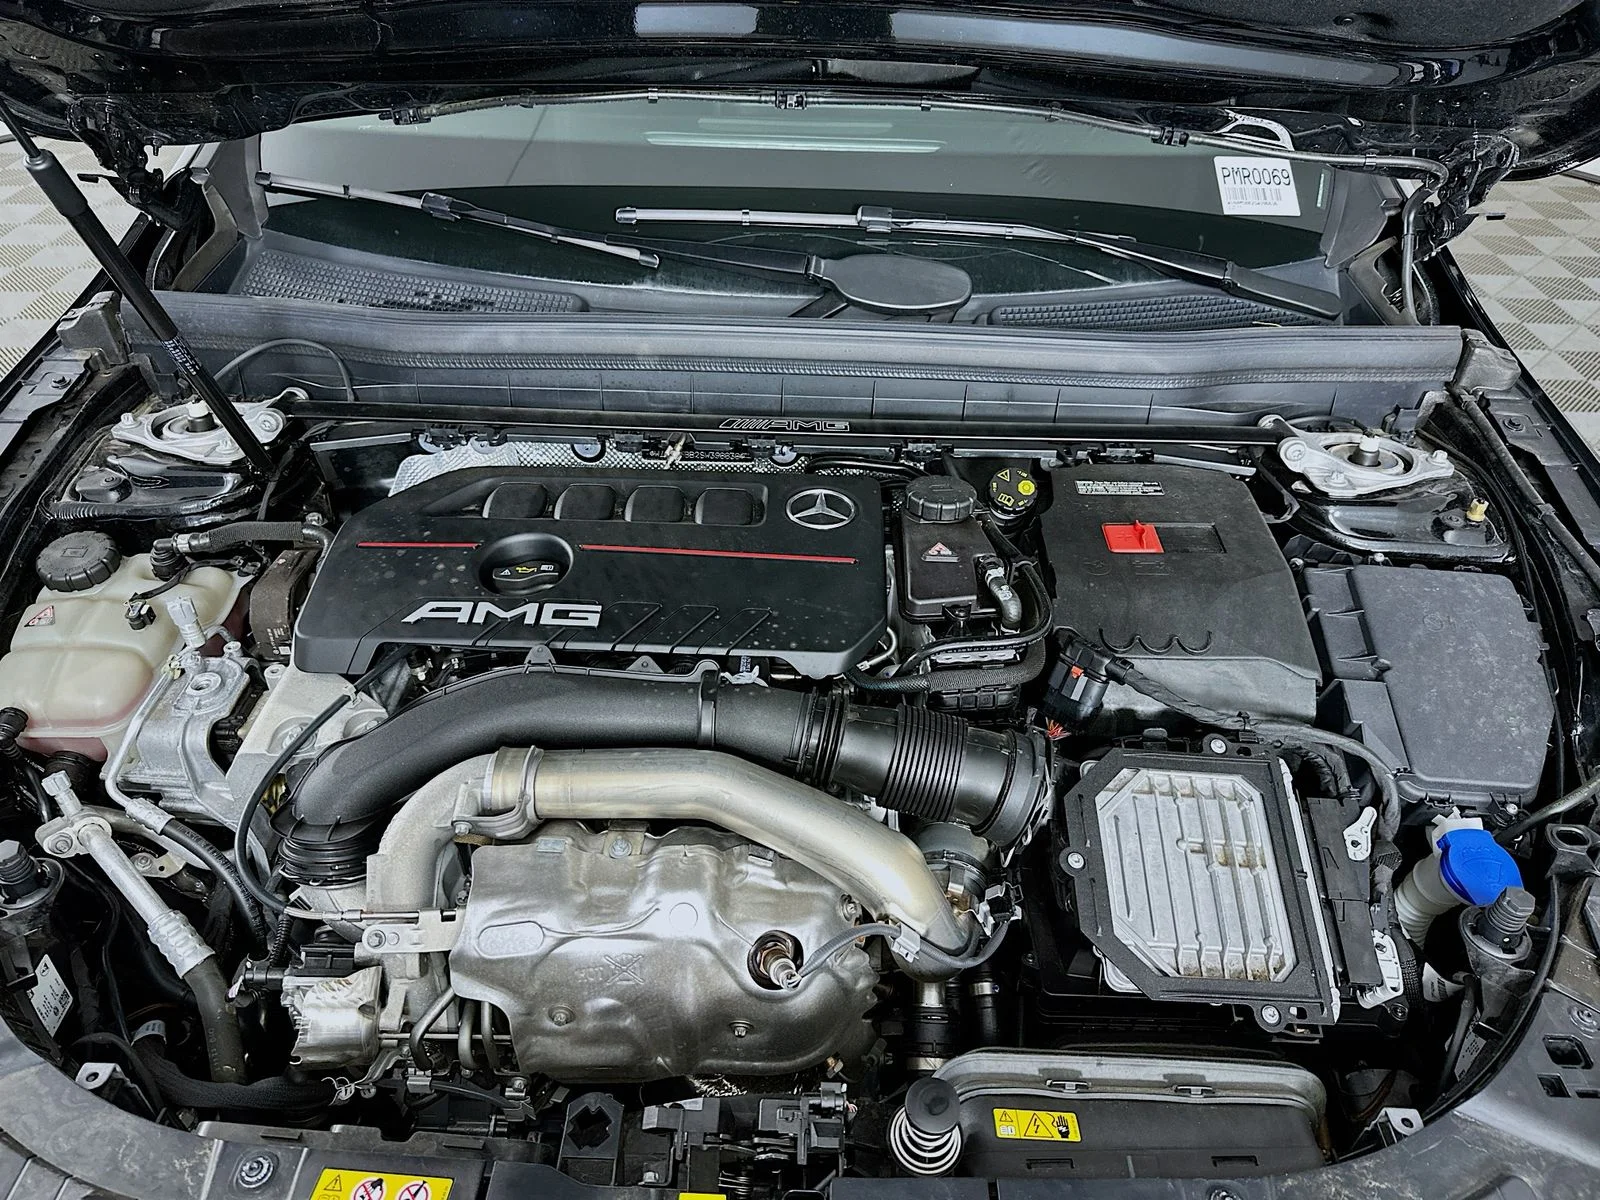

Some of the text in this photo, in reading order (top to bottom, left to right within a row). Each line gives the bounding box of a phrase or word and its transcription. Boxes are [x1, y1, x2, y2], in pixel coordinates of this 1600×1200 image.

[1221, 166, 1291, 186] PMR0069
[764, 419, 850, 432] AMG
[401, 601, 603, 629] AMG
